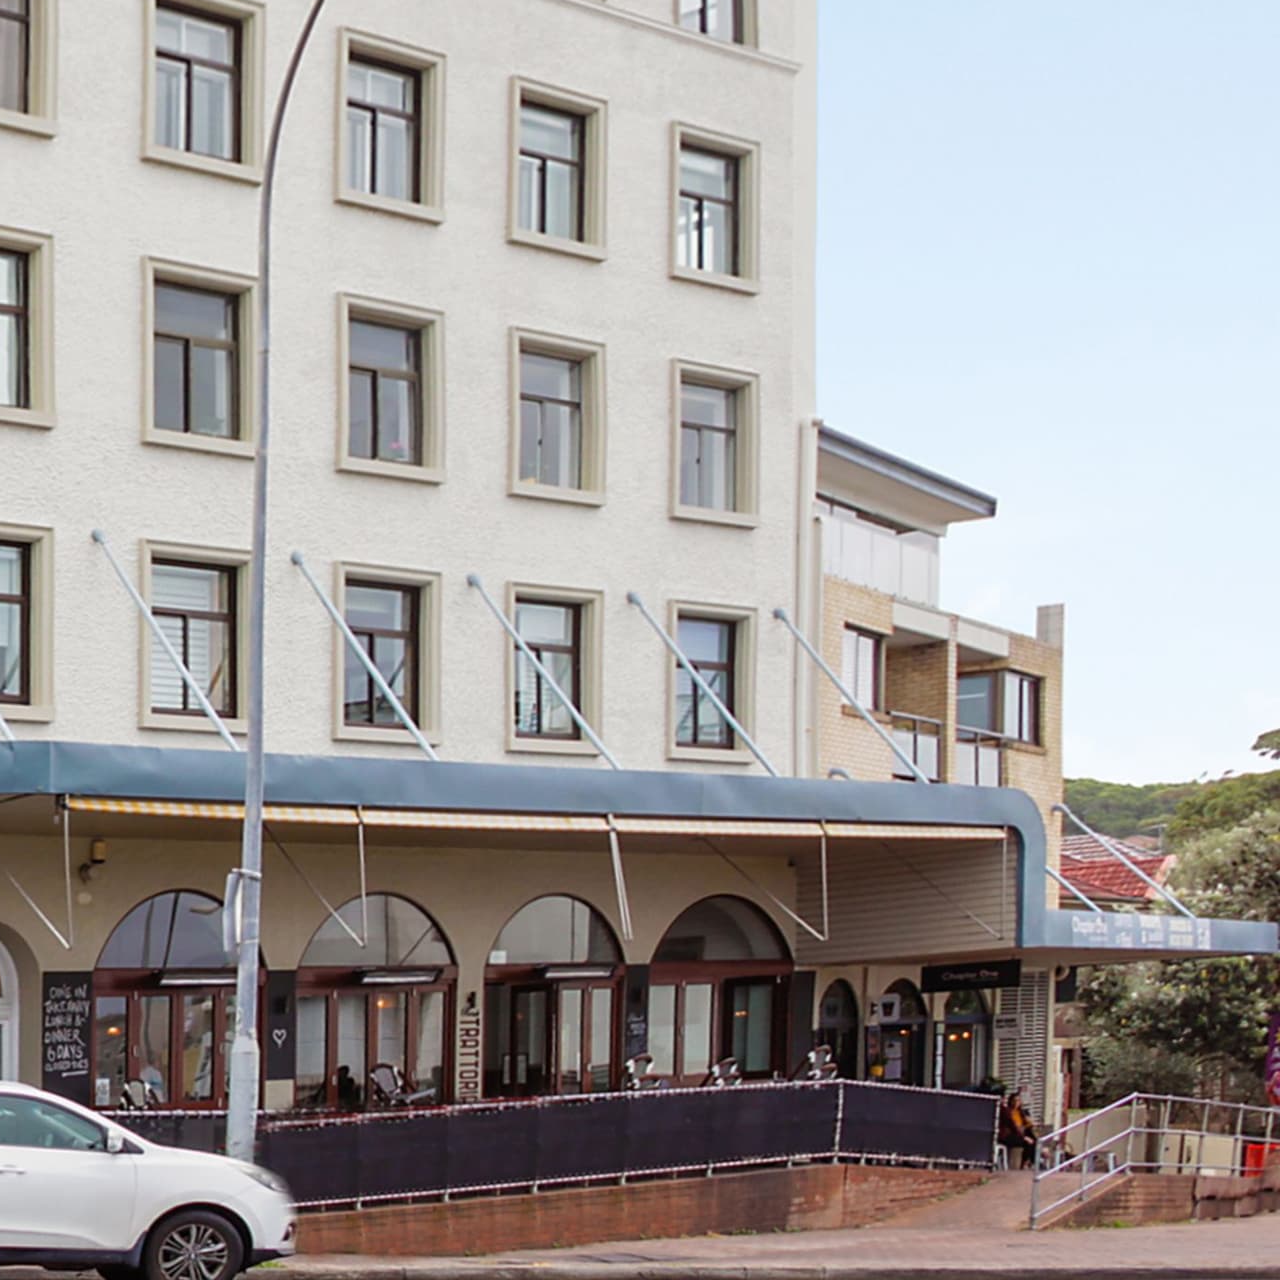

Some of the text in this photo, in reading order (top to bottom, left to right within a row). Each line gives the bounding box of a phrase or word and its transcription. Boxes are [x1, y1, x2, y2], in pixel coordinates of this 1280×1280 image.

[74, 984, 88, 998] IN
[45, 1027, 86, 1046] DINNER
[47, 1045, 83, 1061] 6 DAYS
